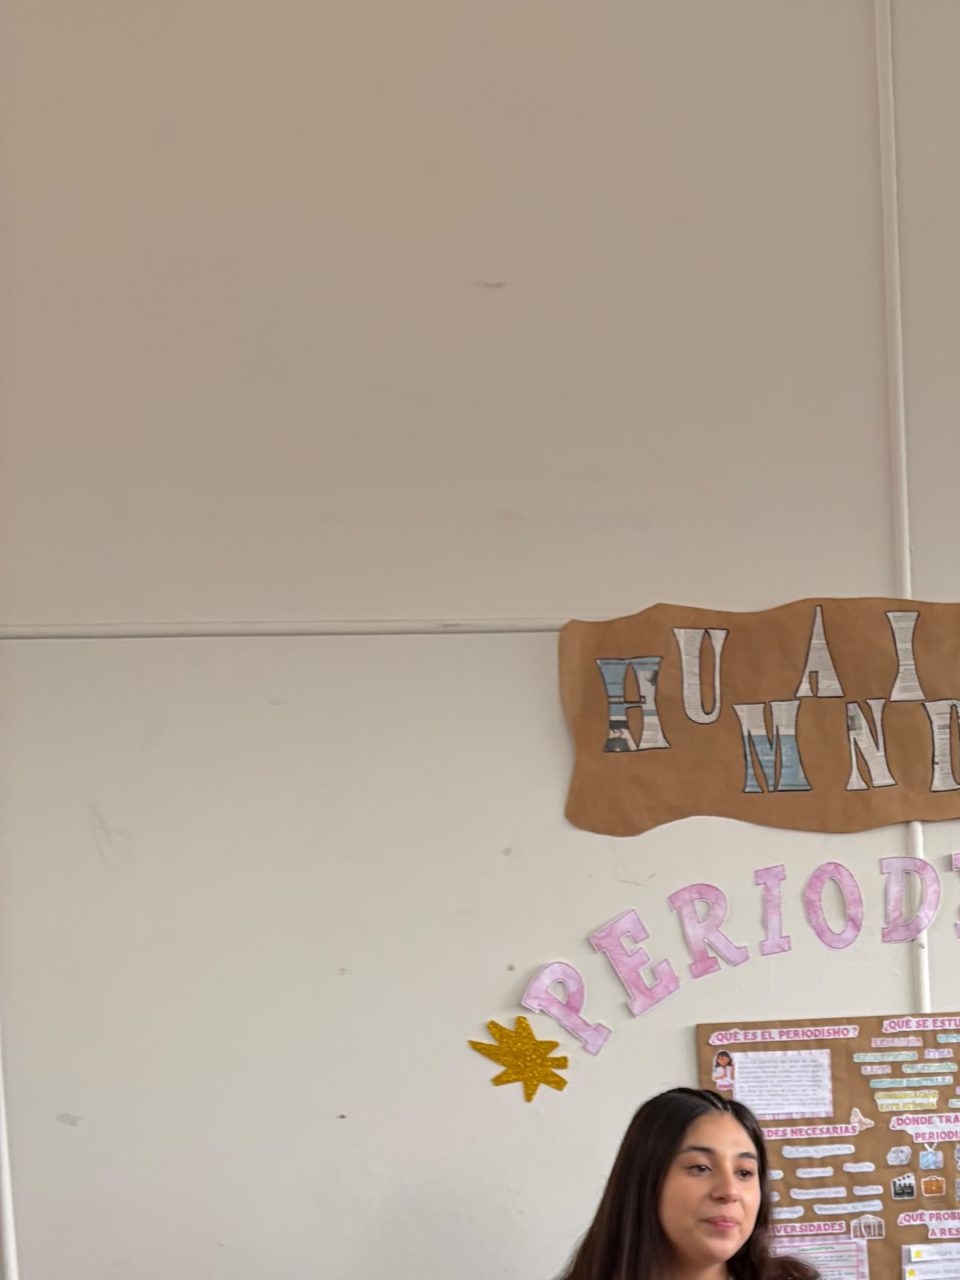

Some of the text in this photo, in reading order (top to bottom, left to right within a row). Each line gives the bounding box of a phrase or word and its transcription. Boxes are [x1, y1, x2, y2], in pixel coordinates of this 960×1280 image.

[915, 1018, 929, 1028] SE
[744, 1031, 758, 1041] ES
[761, 1030, 775, 1040] EL
[779, 1027, 850, 1040] PERIODISMO
[790, 1125, 857, 1137] NECESARIAS
